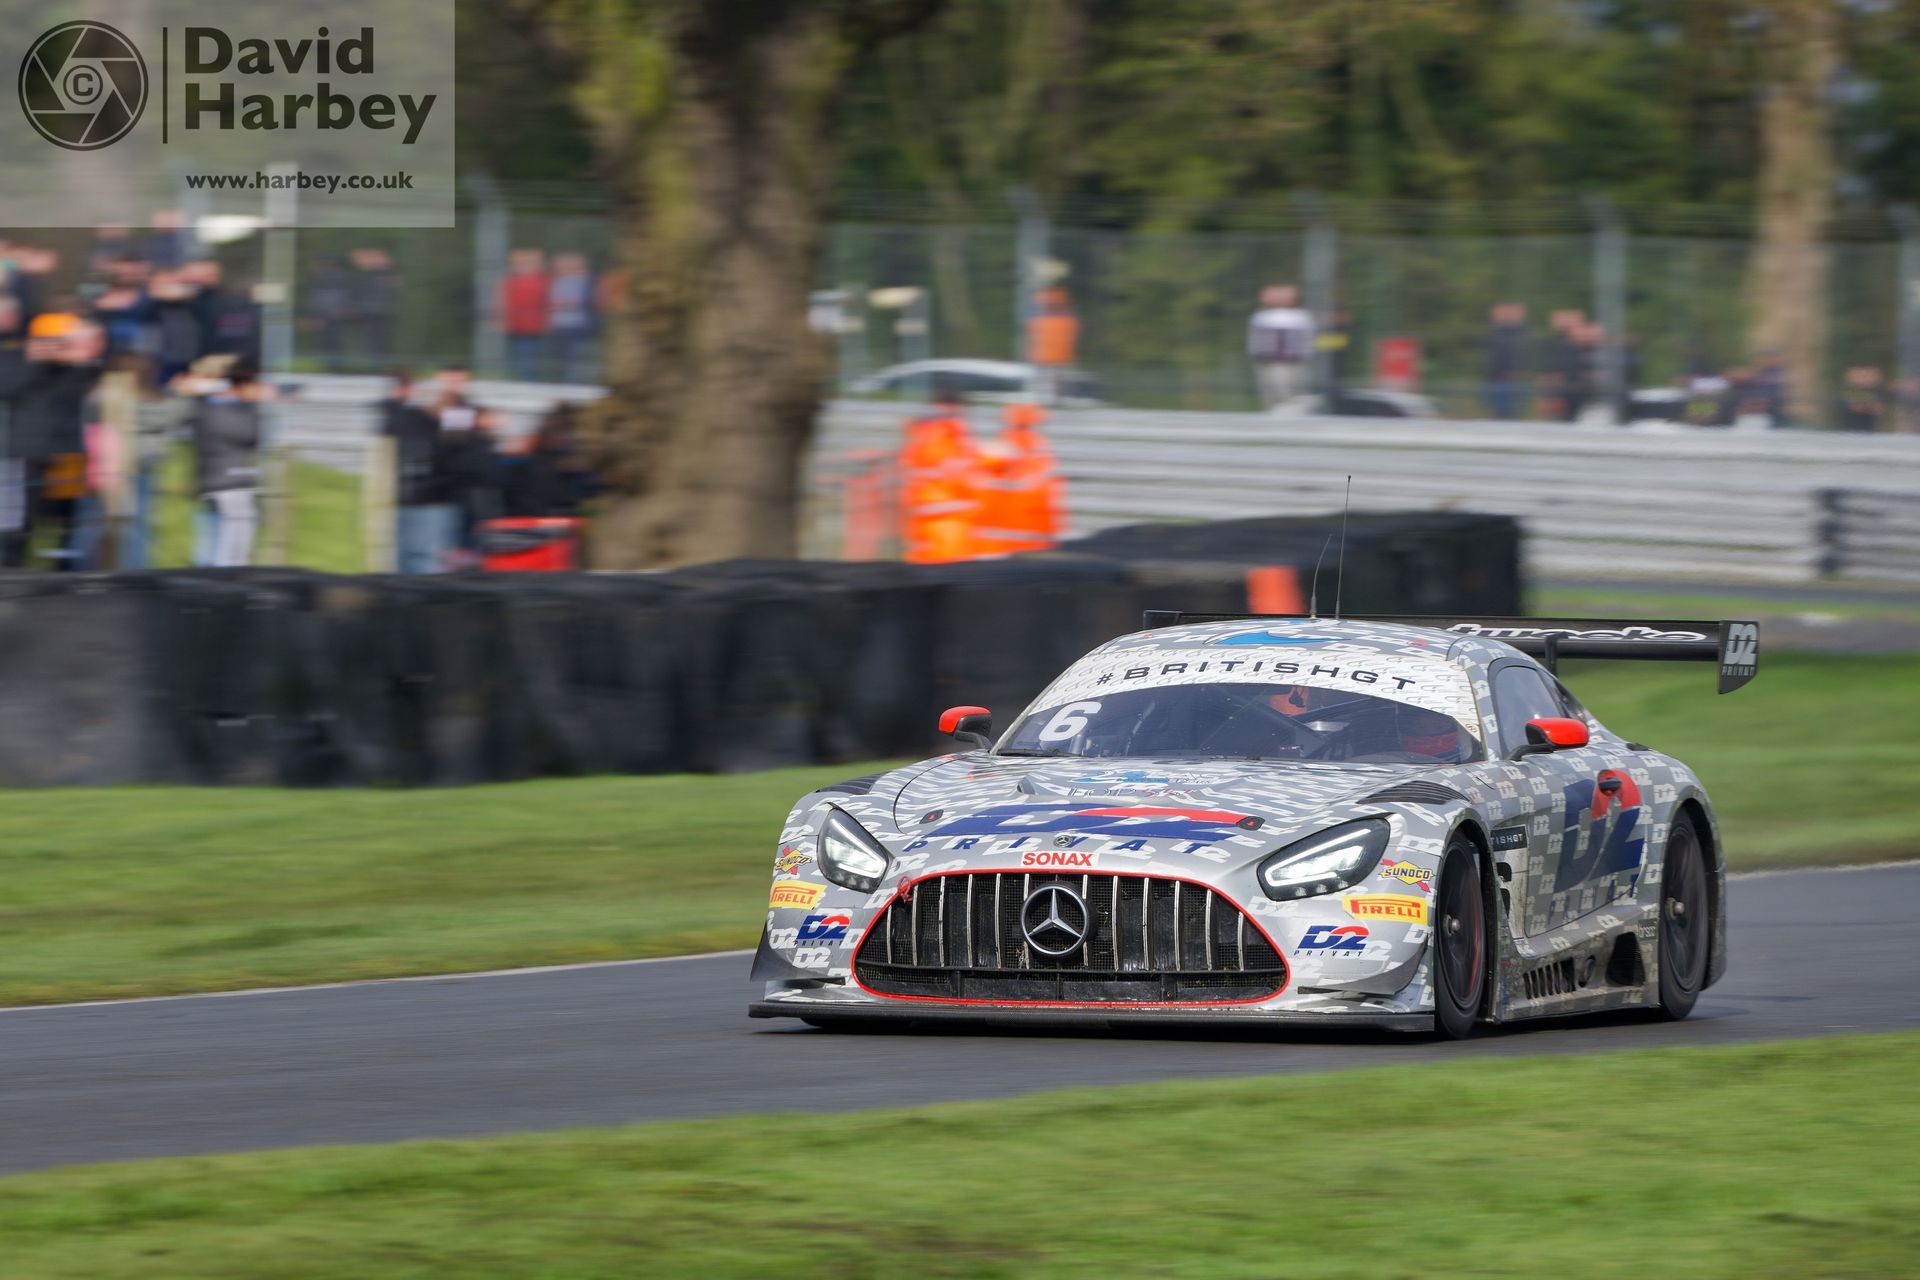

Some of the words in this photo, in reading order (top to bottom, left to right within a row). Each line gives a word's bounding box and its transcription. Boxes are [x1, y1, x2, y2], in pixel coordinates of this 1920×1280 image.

[1096, 661, 1416, 690] #BRITISHGT
[1039, 701, 1102, 741] 6
[903, 836, 1212, 854] PRIVAT
[1022, 852, 1093, 867] SONAX
[1384, 868, 1430, 881] SUNOCO
[770, 886, 818, 905] PIRELLI
[1350, 899, 1421, 918] PIRELLI
[796, 915, 851, 940] D2
[1297, 926, 1370, 950] D2
[792, 947, 831, 968] D2
